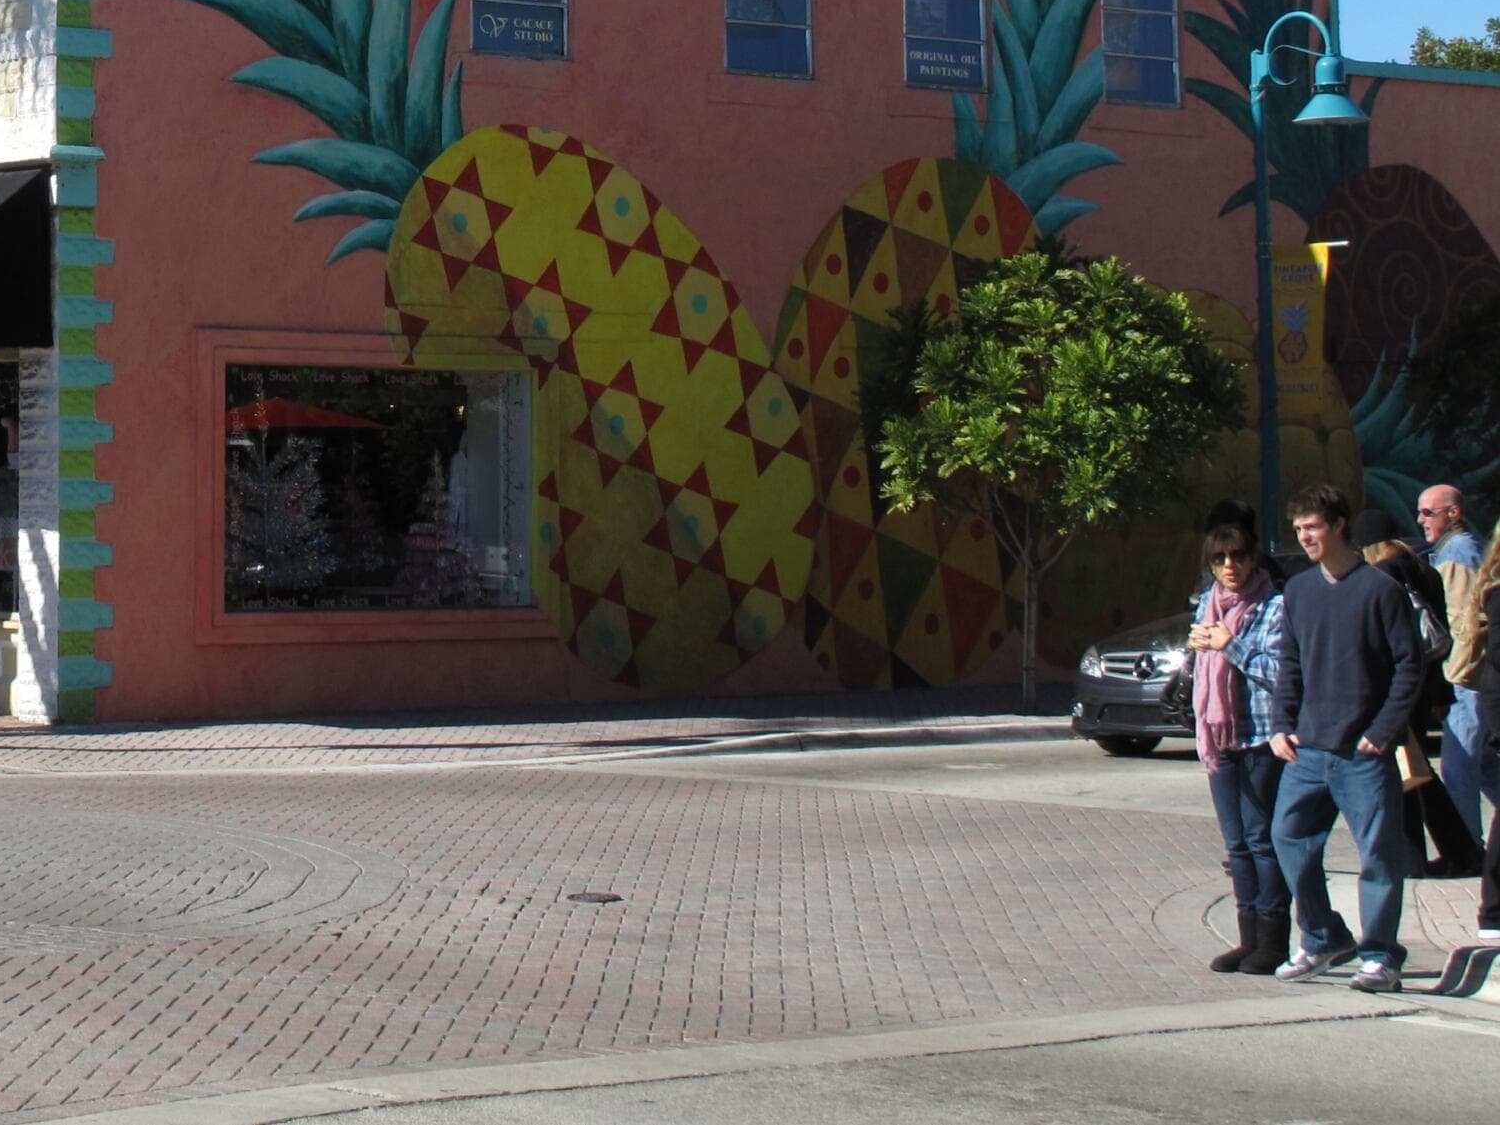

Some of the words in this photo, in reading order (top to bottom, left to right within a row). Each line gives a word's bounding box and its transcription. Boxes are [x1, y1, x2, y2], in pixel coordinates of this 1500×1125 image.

[513, 18, 554, 30] CACACE
[514, 30, 554, 43] STUDIO
[909, 50, 956, 63] ORIGINAL
[961, 53, 978, 65] OIL
[919, 65, 969, 78] PAINTINGS
